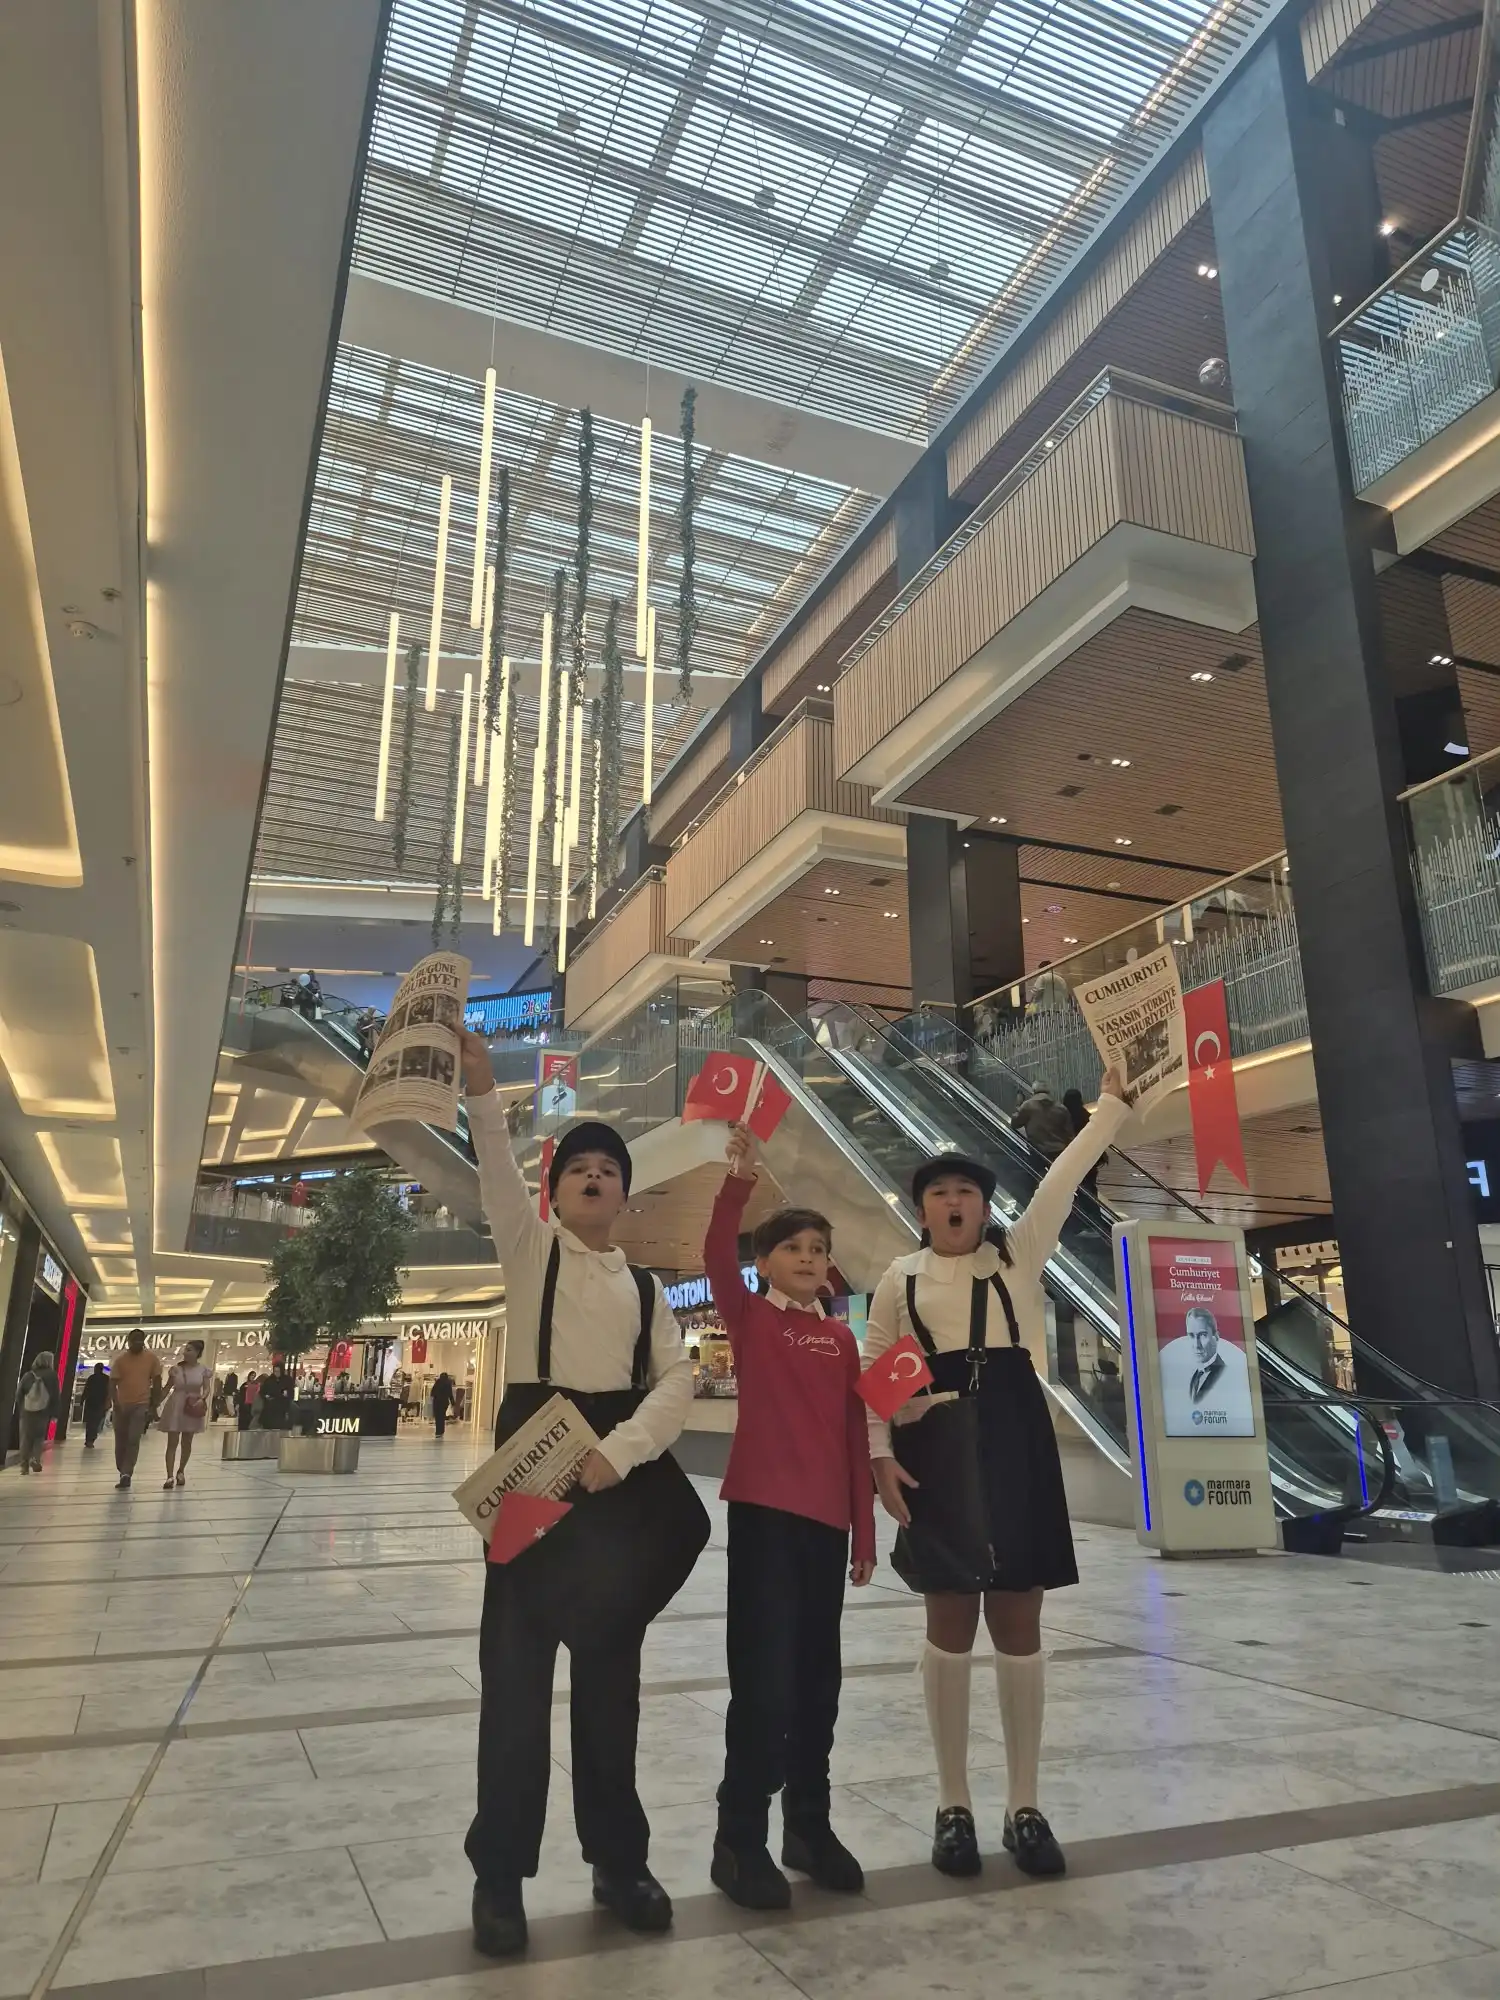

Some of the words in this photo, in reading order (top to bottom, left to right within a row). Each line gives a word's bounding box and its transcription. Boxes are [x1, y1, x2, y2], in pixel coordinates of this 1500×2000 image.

[1084, 955, 1169, 1004] CUMHURİYET
[1140, 985, 1177, 1019] TÜRKİYE
[1169, 1265, 1221, 1281] Cumhuriyet
[476, 1417, 571, 1519] CUMHURİYET
[1206, 1480, 1251, 1490] marmara
